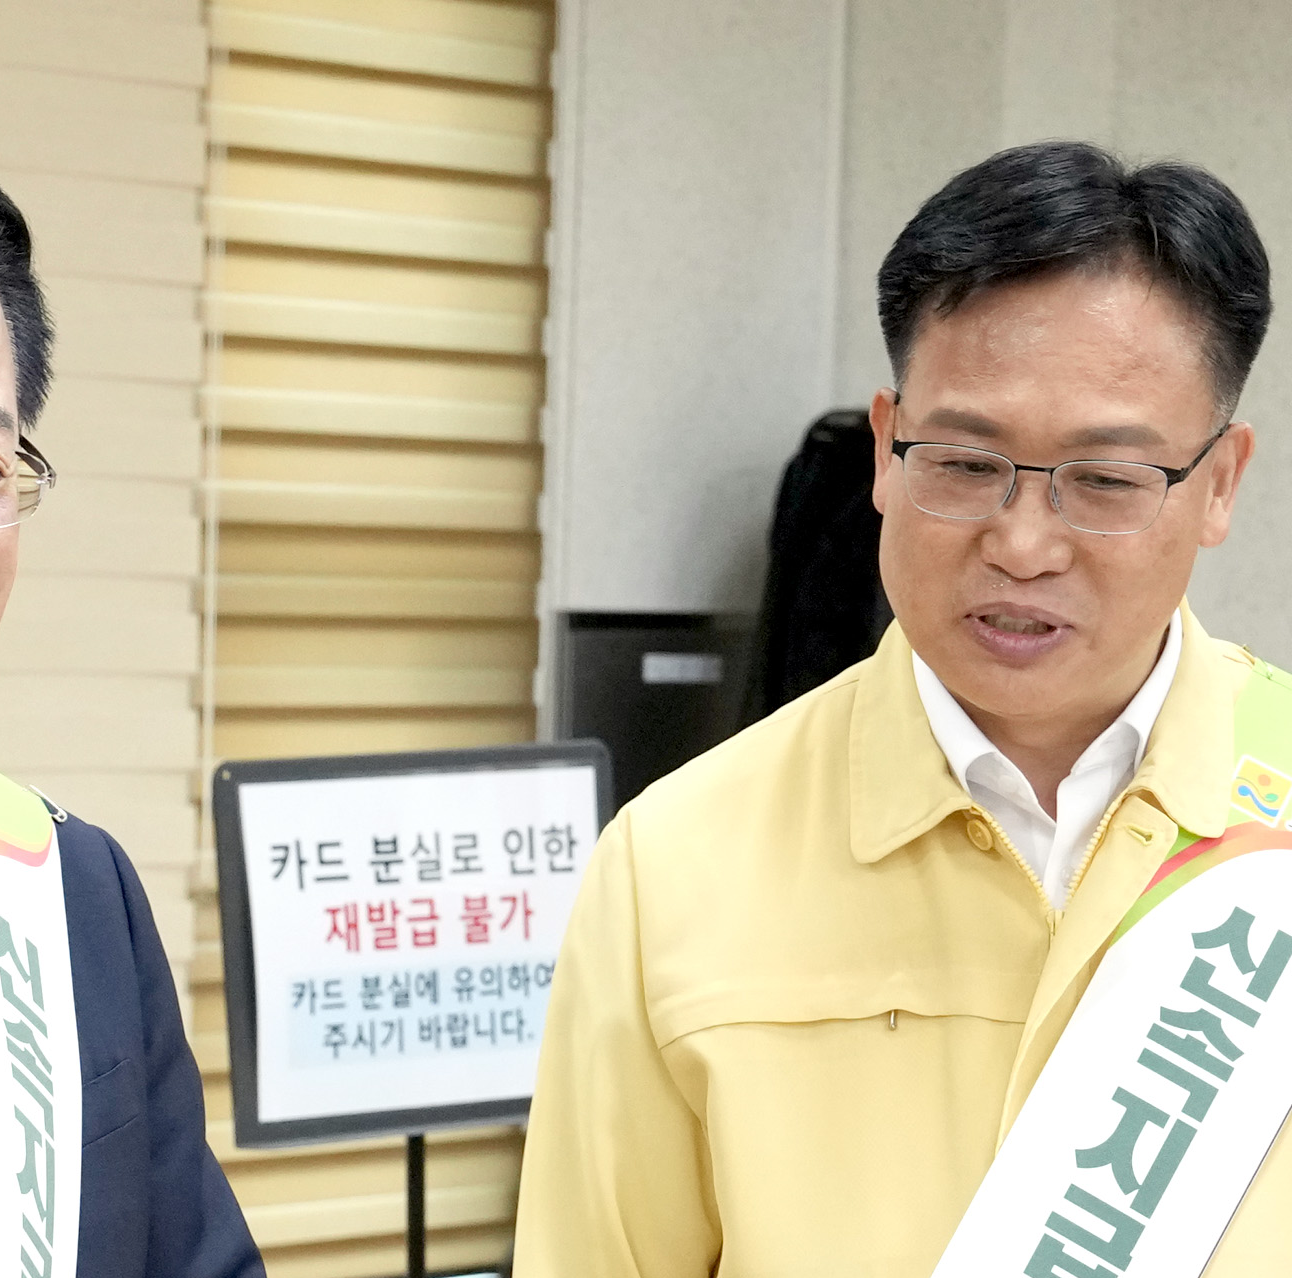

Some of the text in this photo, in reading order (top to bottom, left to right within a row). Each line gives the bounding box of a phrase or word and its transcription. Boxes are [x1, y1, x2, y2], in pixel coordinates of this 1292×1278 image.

[270, 824, 579, 891] 카드 분실로 인한
[324, 890, 535, 953] 재발급 불가
[291, 978, 347, 1016] 카드
[358, 968, 441, 1011] 분실에
[322, 1008, 536, 1060] 주시기 바랍니다.
